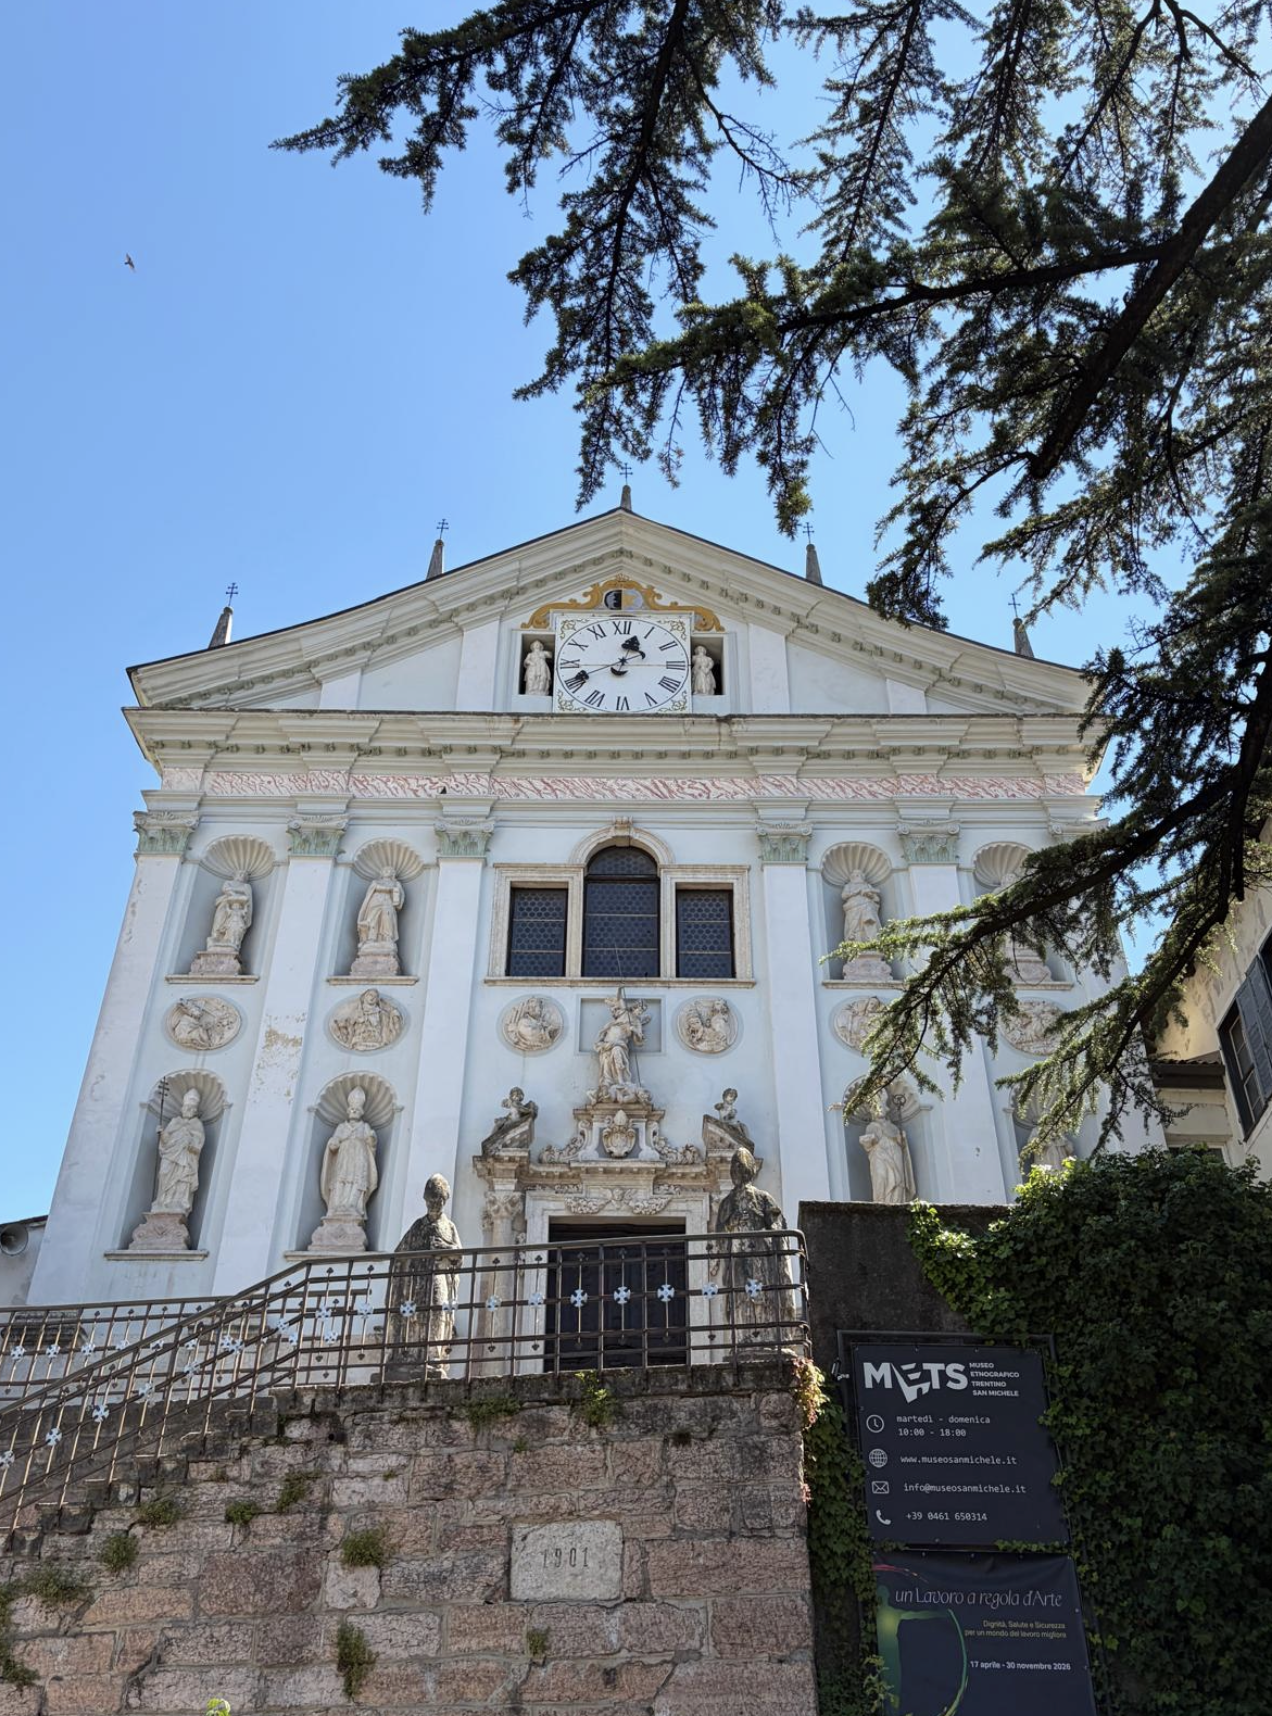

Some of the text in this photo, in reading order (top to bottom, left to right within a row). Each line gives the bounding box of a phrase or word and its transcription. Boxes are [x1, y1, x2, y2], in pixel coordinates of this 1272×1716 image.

[587, 624, 607, 640] XI
[613, 621, 632, 635] XII
[616, 696, 630, 711] VI
[863, 1362, 969, 1403] METS
[971, 1380, 1007, 1388] TRENTINO
[896, 1415, 933, 1423] martedì
[949, 1415, 991, 1424] domenica
[898, 1428, 925, 1437] 10:00
[940, 1428, 967, 1437] 18:00
[900, 1455, 1017, 1465] www.museosanmichele.it
[904, 1482, 1026, 1494] info@museosanmichele.it
[906, 1511, 988, 1521] +39 0461 650314
[543, 1547, 589, 1569] 1901
[895, 1587, 1063, 1610] un Lavoro a regola d'Arte
[1034, 1621, 1066, 1629] Sicurezza
[986, 1629, 1009, 1637] mondo
[1020, 1630, 1041, 1638] lavoro
[980, 1661, 1001, 1669] aprile
[1006, 1661, 1016, 1669] 30
[1016, 1662, 1052, 1670] novembre
